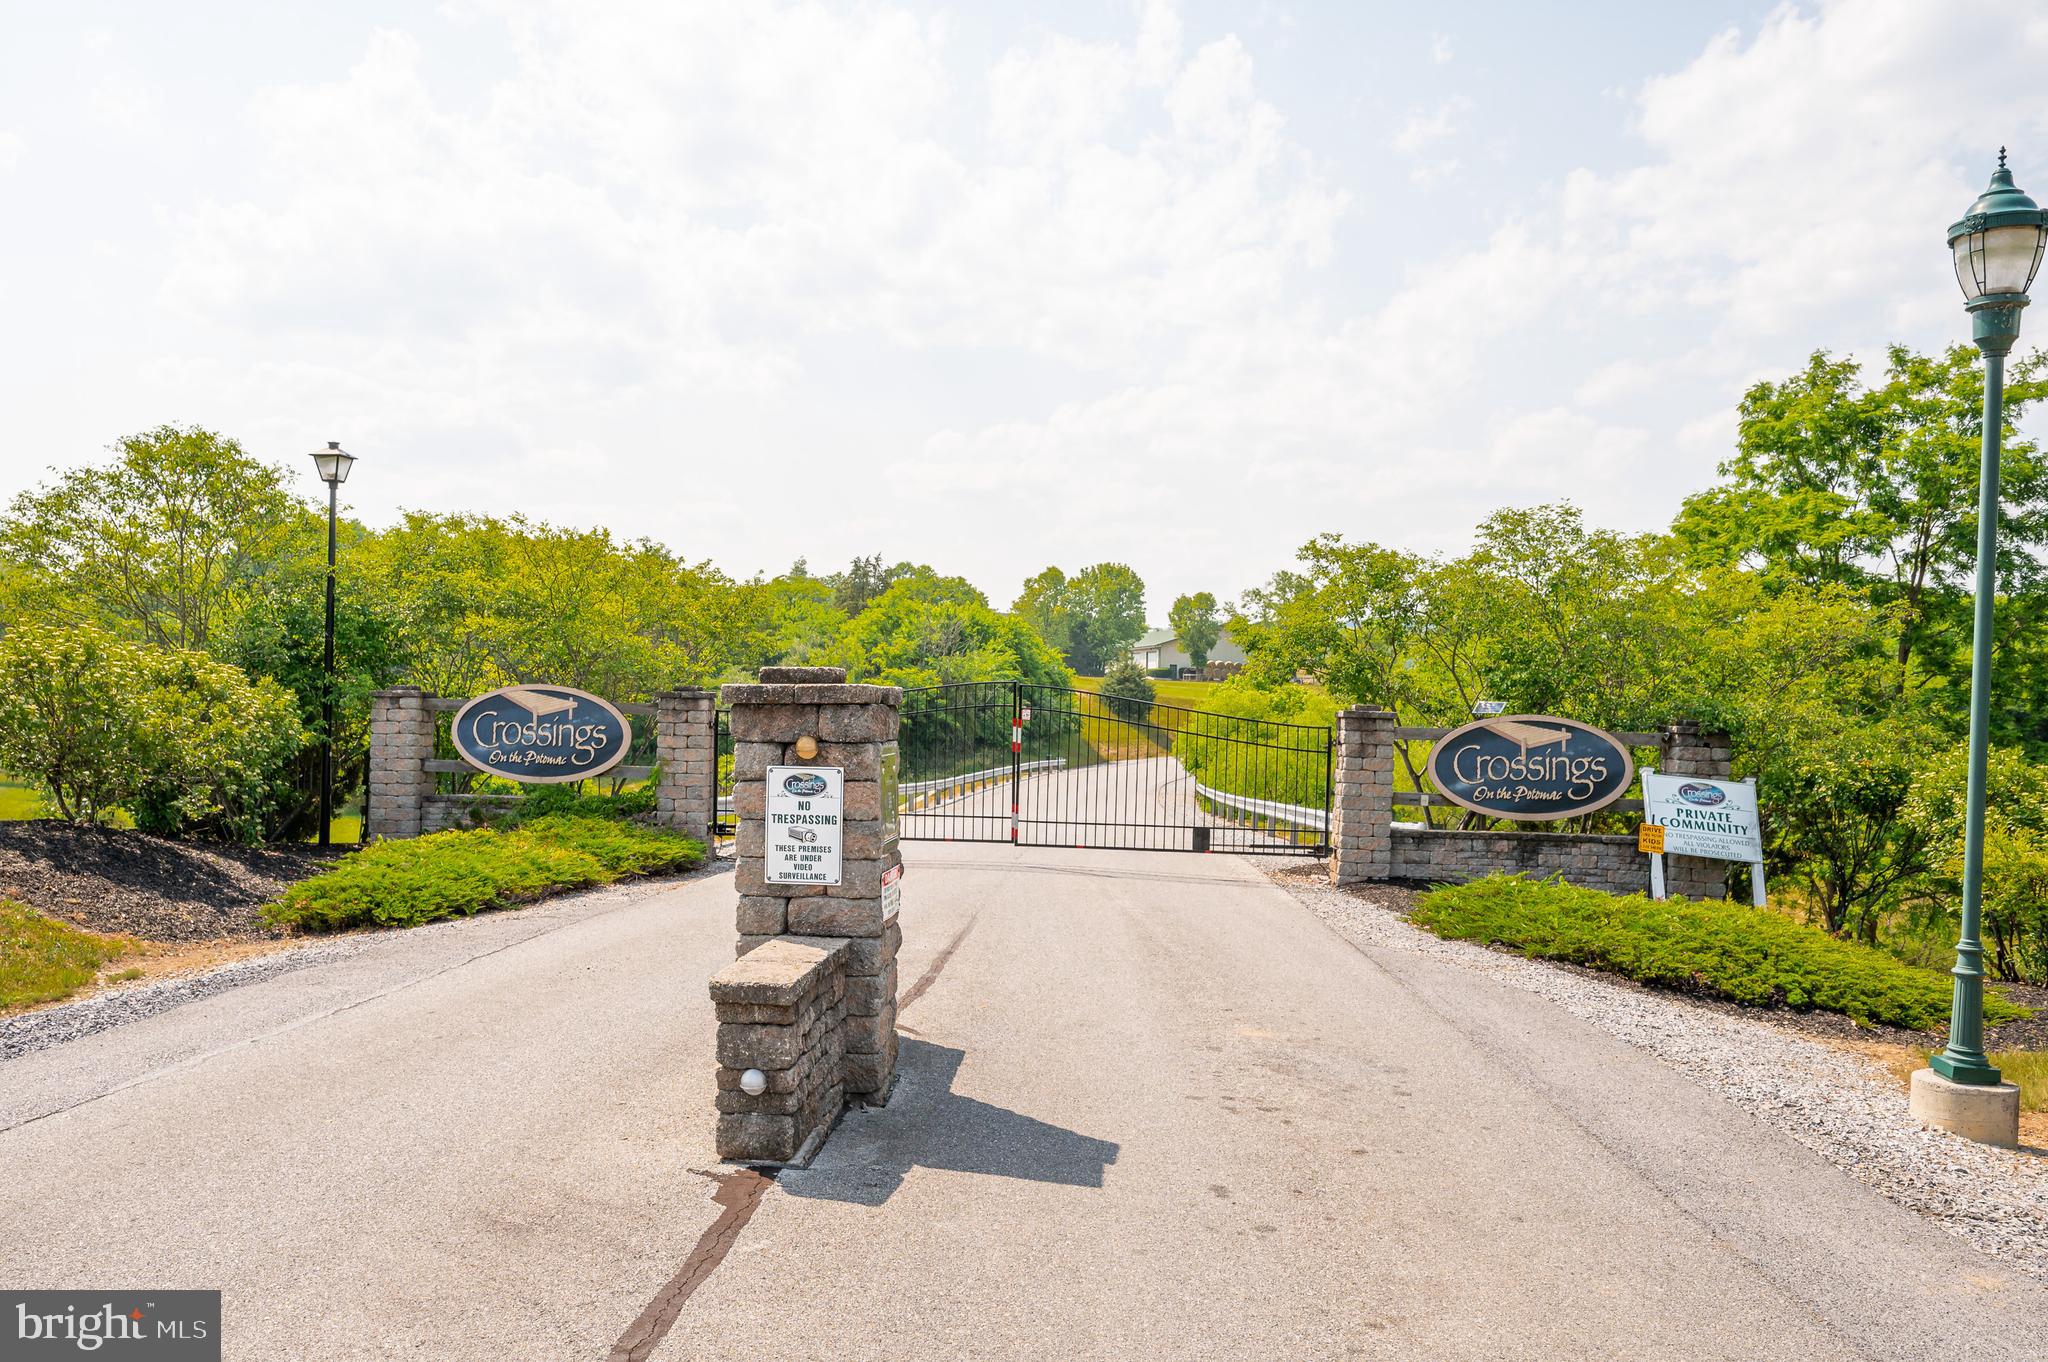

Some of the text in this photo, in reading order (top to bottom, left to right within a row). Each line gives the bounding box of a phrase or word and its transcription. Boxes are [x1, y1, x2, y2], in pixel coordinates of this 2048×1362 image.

[473, 711, 607, 765] Crossings
[489, 750, 567, 766] On the Potomac
[1453, 745, 1608, 800] Crossings
[786, 778, 824, 794] Crossings
[1472, 786, 1562, 802] On the Potomac
[1681, 786, 1723, 804] Crossings
[798, 801, 811, 811] NO
[771, 813, 837, 826] TRESPASSING
[1676, 808, 1732, 823] PRIVATE
[1642, 826, 1662, 834] DRIVE
[1660, 816, 1749, 835] COMMUNITY
[1642, 837, 1662, 845] KIDS
[1675, 833, 1717, 843] TRESPASSING
[1719, 838, 1750, 847] ALLOWED
[1696, 841, 1731, 851] VIOLATORS
[775, 844, 832, 853] THESE PREMISES
[1700, 848, 1743, 858] PROSECUTED
[793, 863, 813, 871] VIDEO
[779, 872, 827, 881] SURVEILLANCE
